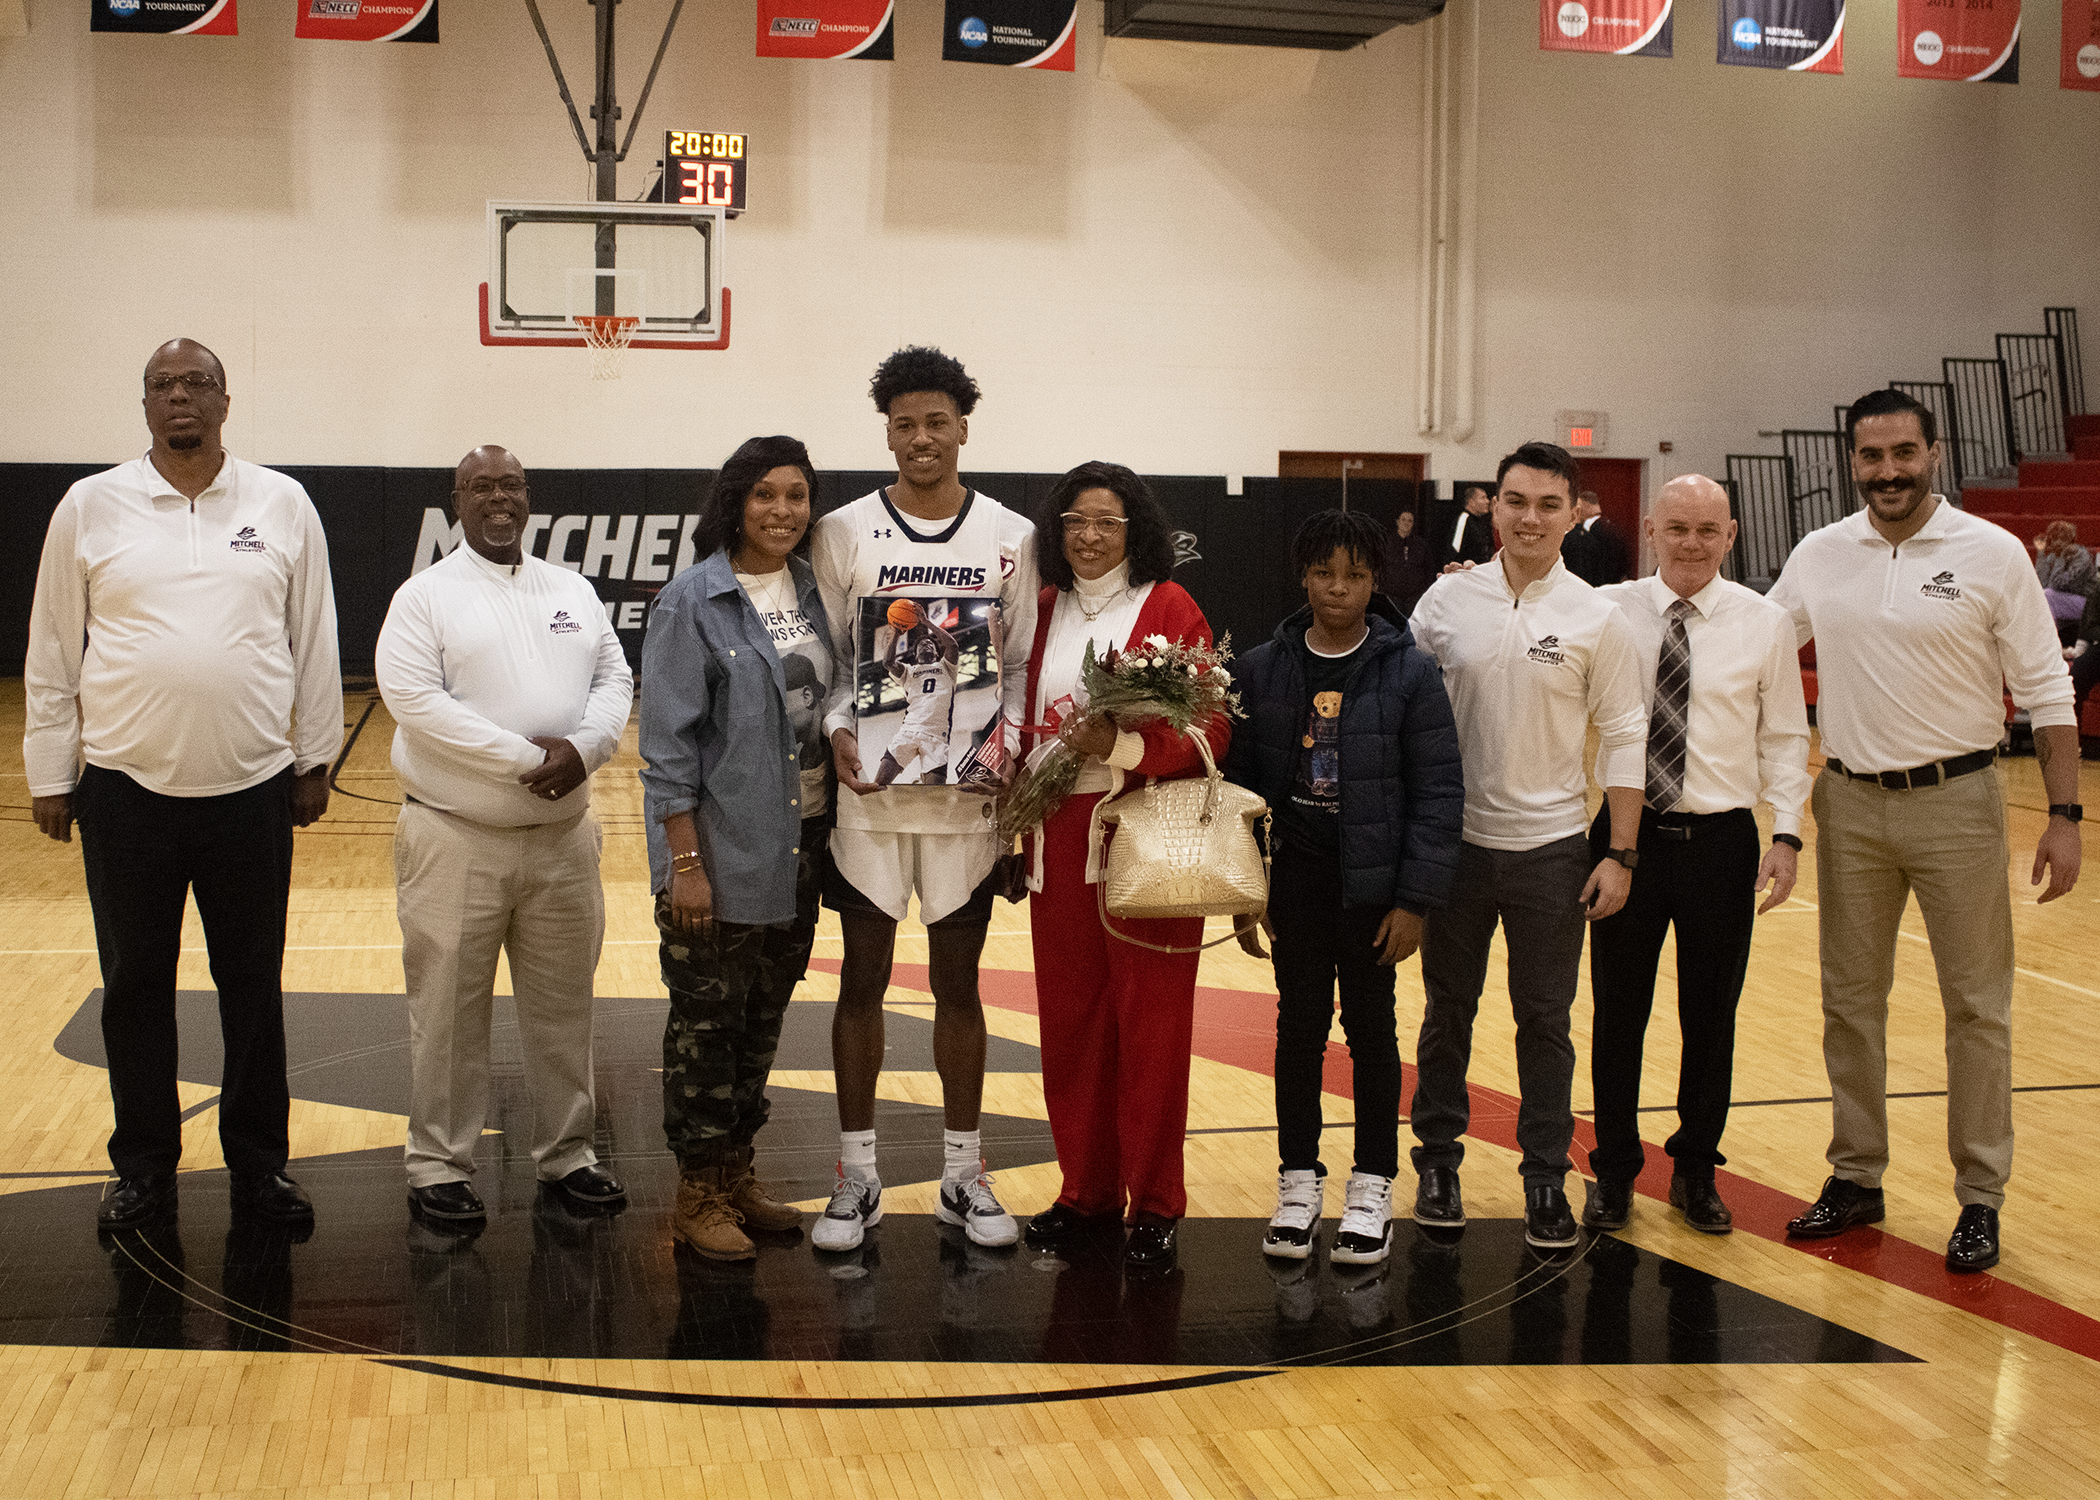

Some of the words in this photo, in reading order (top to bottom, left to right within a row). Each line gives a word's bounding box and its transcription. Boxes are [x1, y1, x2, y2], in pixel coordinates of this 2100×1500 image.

[109, 0, 140, 9] NCAA
[145, 2, 206, 12] TOURNAMENT
[362, 5, 414, 15] CHAMPIONS
[821, 24, 870, 34] CHAMPIONS
[992, 25, 1033, 37] NATIONAL
[1765, 26, 1805, 38] NATIONAL
[960, 30, 988, 42] NCAA
[992, 35, 1048, 47] TOURNAMENT
[1765, 36, 1819, 49] TOURNAMENT
[670, 131, 744, 158] 20:00
[679, 161, 733, 206] 30
[1571, 428, 1592, 446] EXIT
[230, 540, 265, 549] MITCHELL
[877, 565, 986, 588] MARINERS
[1920, 583, 1961, 596] MITCHELL
[550, 622, 580, 631] MITCHELL
[1527, 646, 1565, 661] MITCHELL
[922, 678, 936, 694] 0
